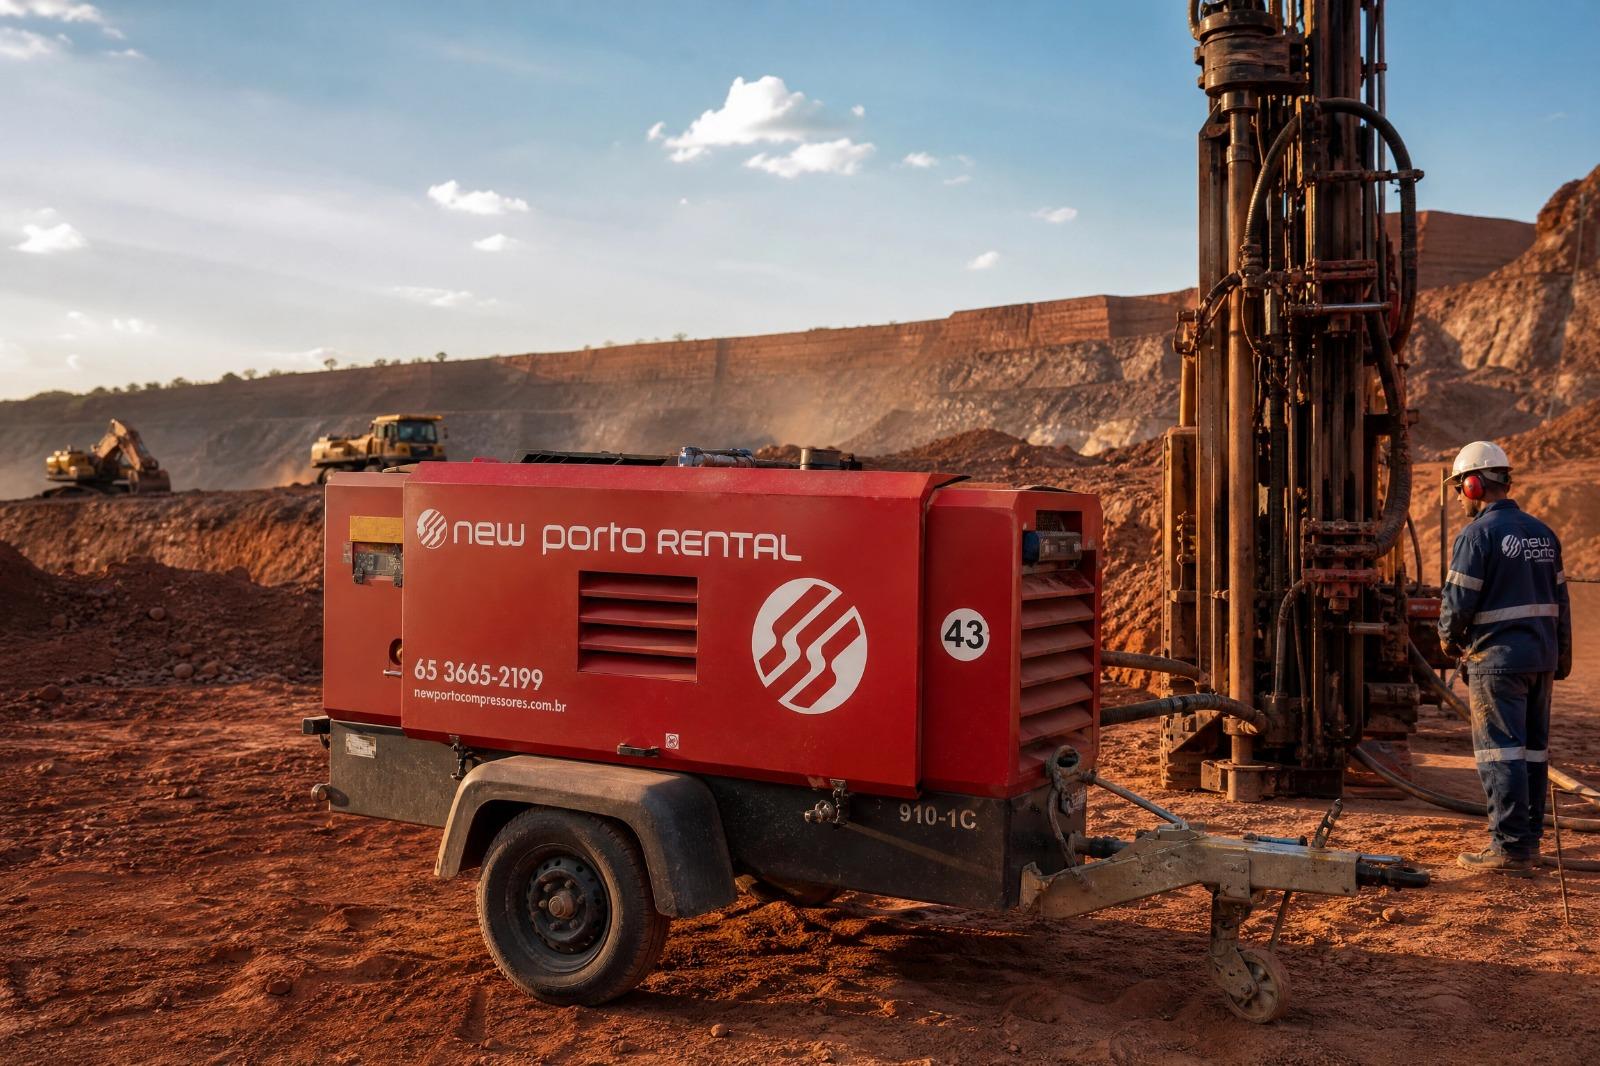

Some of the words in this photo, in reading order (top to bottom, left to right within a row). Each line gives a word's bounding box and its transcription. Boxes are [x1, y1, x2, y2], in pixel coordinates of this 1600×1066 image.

[453, 520, 525, 547] new
[542, 522, 646, 556] porto
[657, 528, 802, 562] RENTAL
[1521, 537, 1550, 548] new
[944, 619, 984, 649] 43
[414, 658, 437, 681] 65
[443, 660, 544, 691] 3665-2199
[414, 688, 567, 712] newportocompressores.com.br
[900, 803, 977, 830] 910-1C
